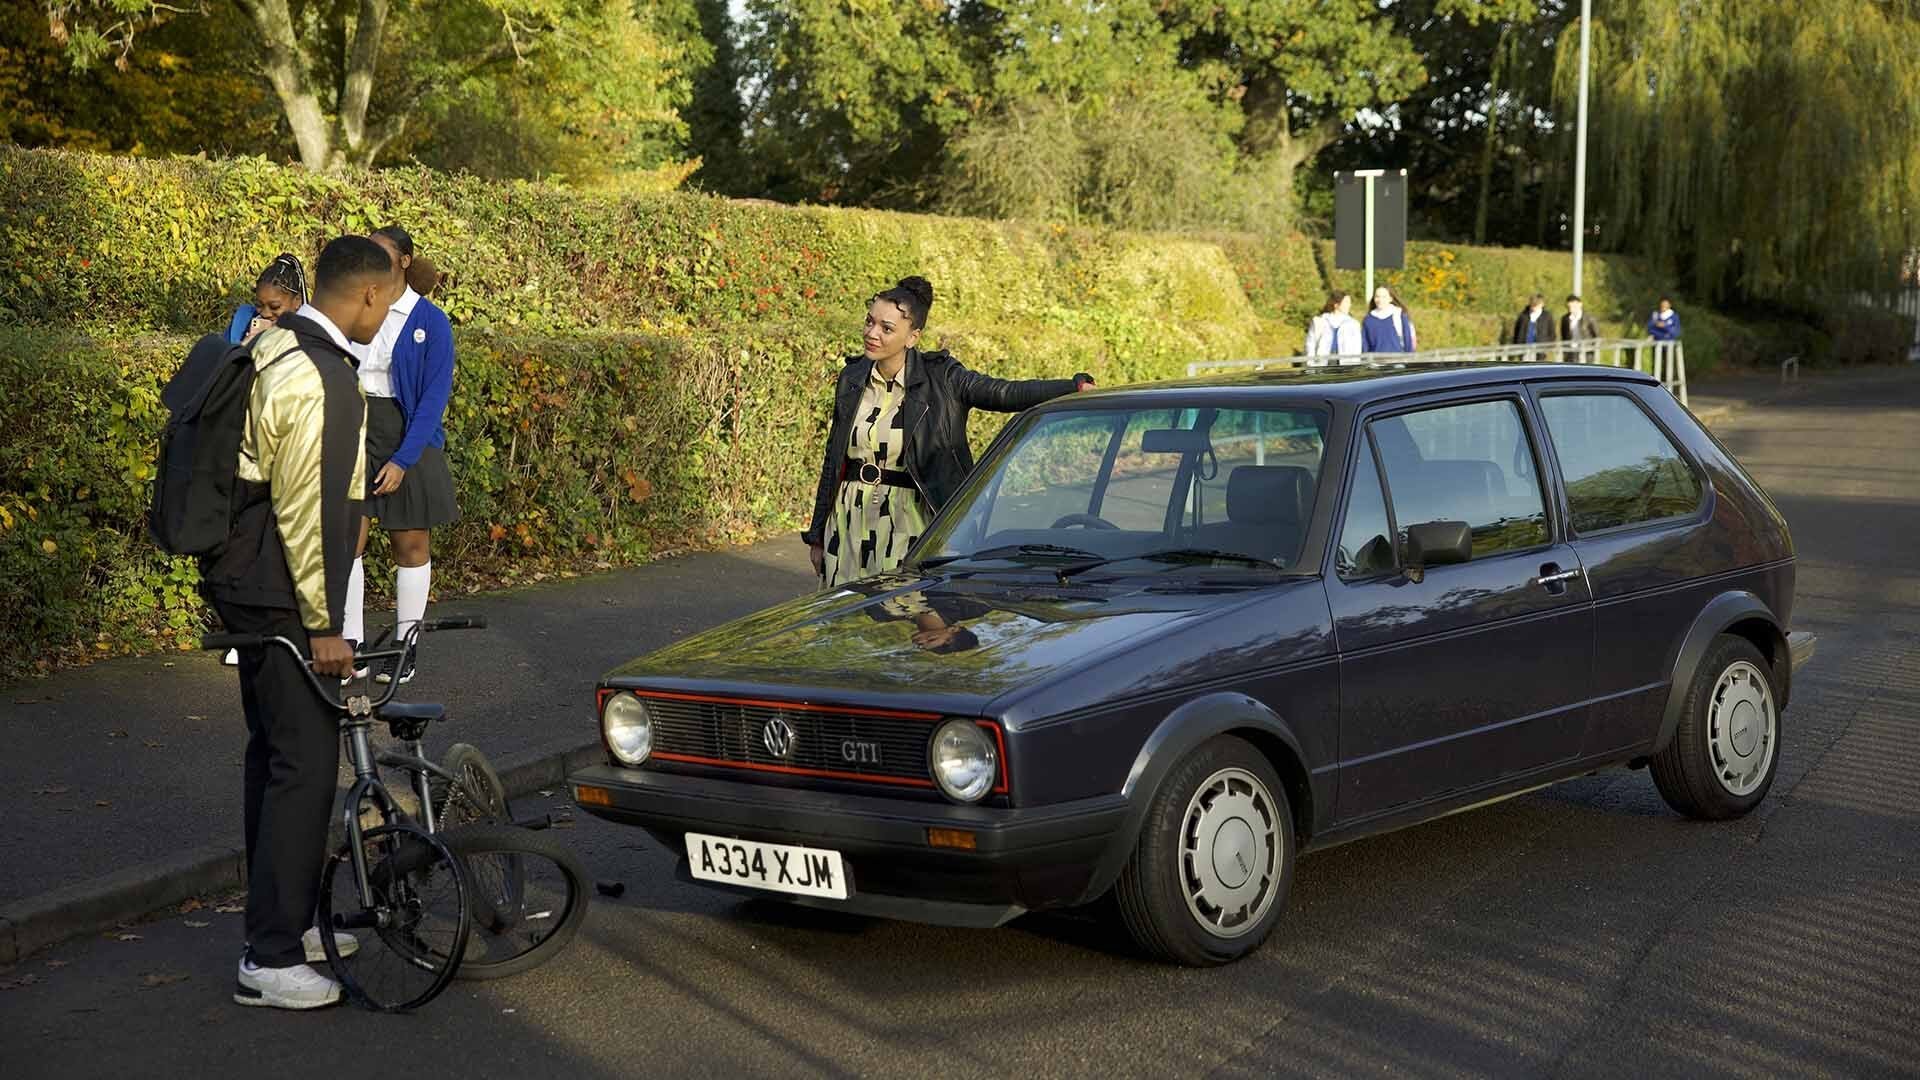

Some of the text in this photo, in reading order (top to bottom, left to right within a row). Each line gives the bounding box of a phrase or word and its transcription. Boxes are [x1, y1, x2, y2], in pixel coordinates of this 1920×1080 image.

[841, 740, 878, 763] GTI
[701, 839, 833, 889] A334 XJM
